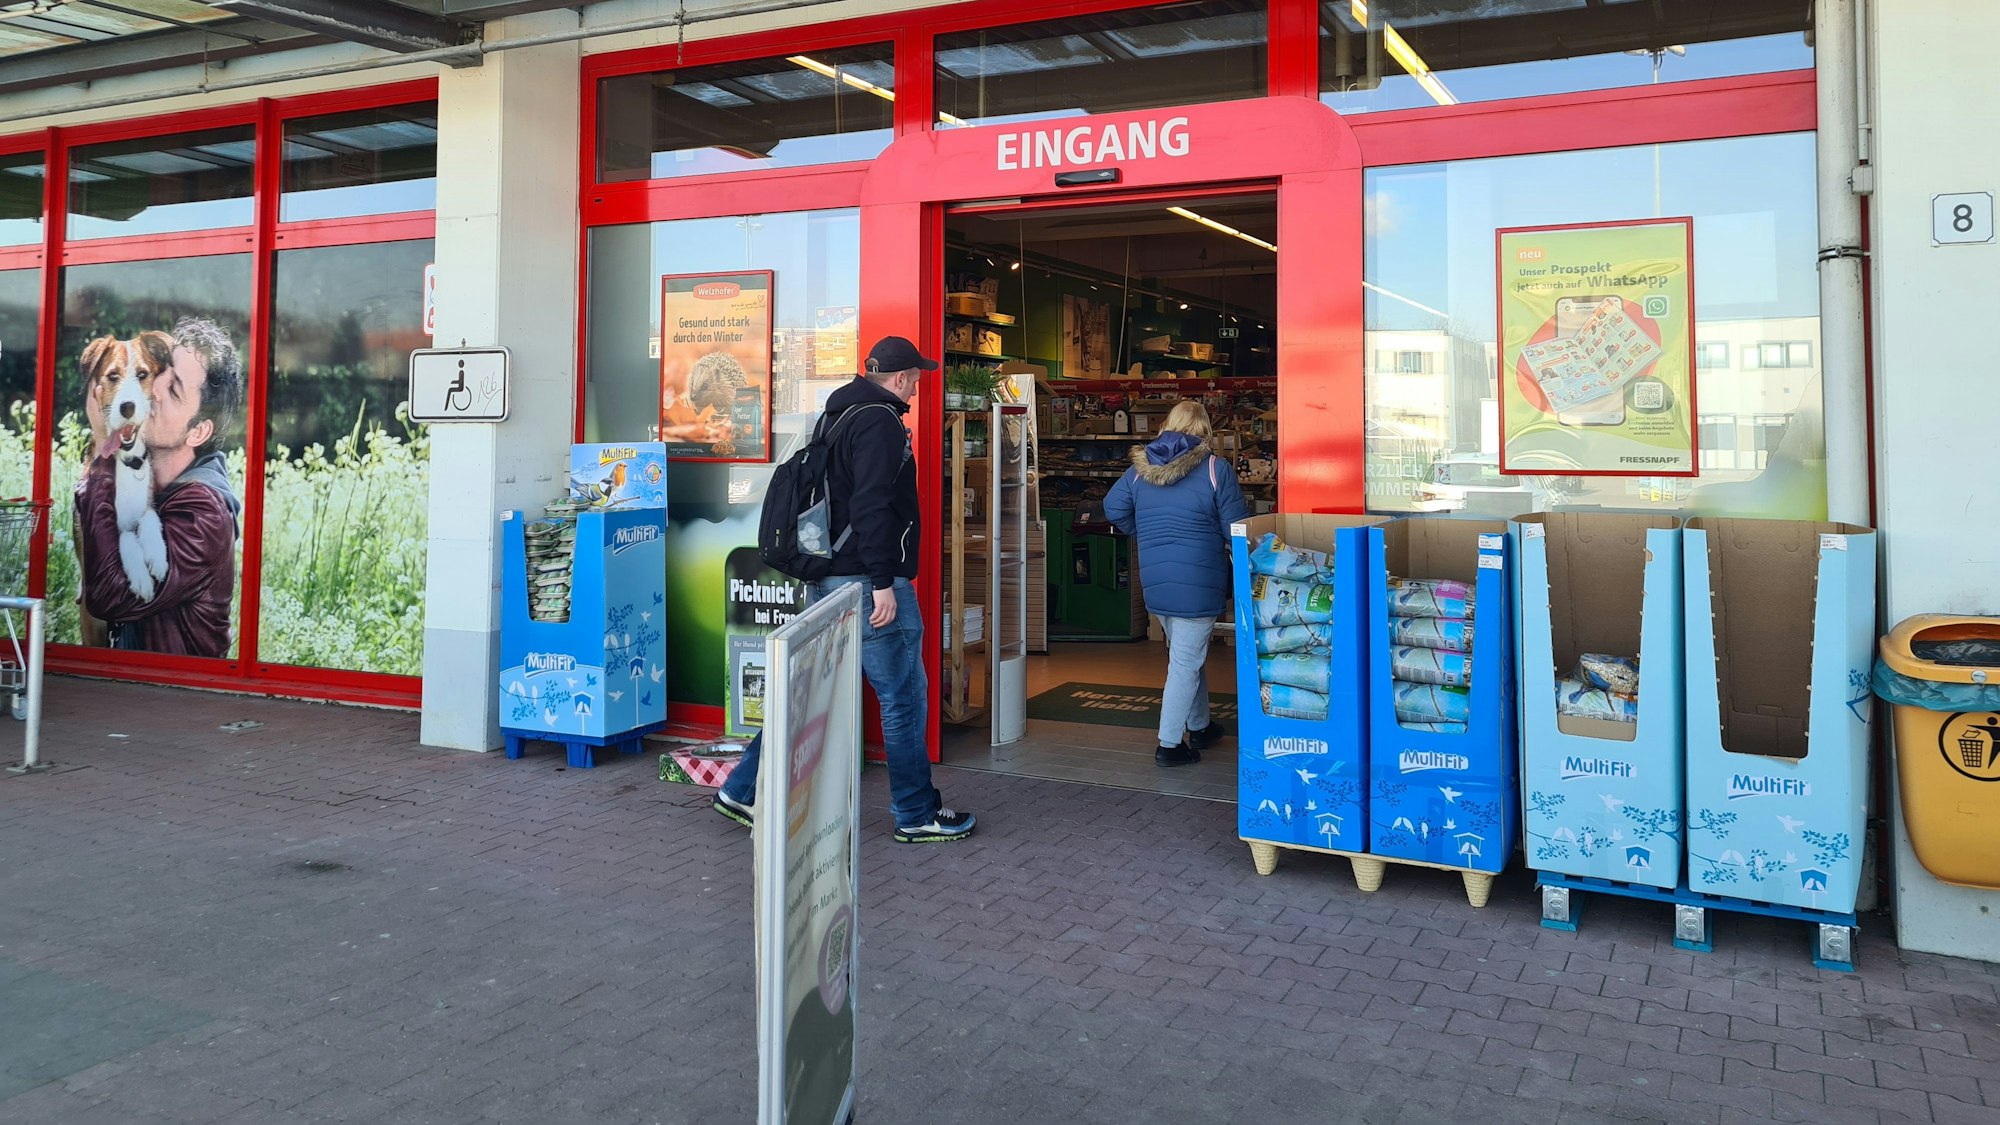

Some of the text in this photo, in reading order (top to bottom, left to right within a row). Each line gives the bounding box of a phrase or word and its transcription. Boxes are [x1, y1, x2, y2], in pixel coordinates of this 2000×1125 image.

[997, 117, 1190, 171] EINGANG
[1953, 204, 1973, 232] 8
[1520, 250, 1541, 259] neu
[1551, 262, 1612, 276] Prospekt
[1517, 274, 1669, 292] jetzt auch auf WhatsApp
[679, 316, 750, 328] Gesund und stark
[673, 331, 744, 343] durch den Winter
[602, 447, 636, 460] MultiFit
[1365, 463, 1424, 478] RZLICH
[616, 526, 656, 544] MultiFit
[730, 578, 795, 605] Picknick
[755, 608, 800, 625] bei Fres
[527, 653, 574, 671] MultiFit
[1070, 690, 1163, 704] Herzlic
[1081, 700, 1150, 712] liebe
[1267, 736, 1325, 754] MultiFit
[1403, 749, 1465, 770] MultiFit
[1565, 756, 1633, 778] MultiFit
[1732, 774, 1807, 796] MultiFit
